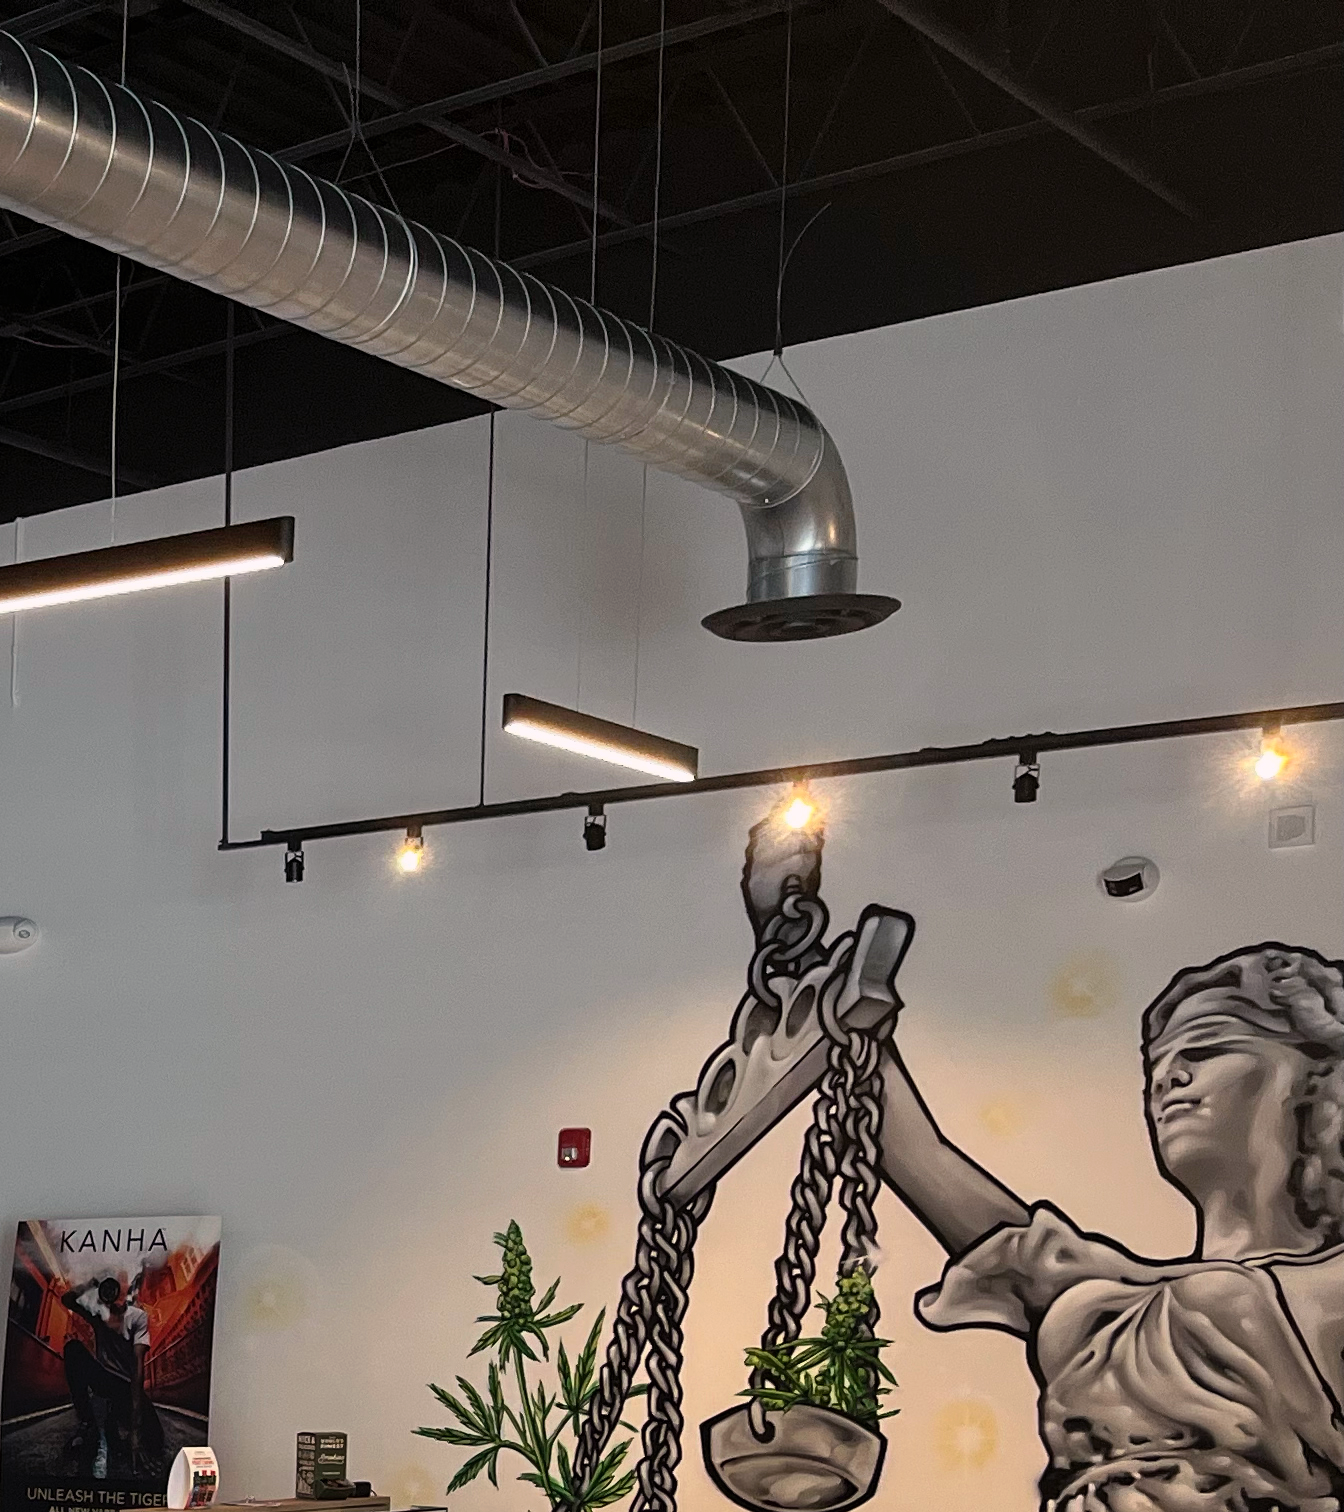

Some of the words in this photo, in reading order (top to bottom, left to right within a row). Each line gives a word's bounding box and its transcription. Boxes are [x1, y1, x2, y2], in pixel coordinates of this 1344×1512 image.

[59, 1227, 169, 1253] KANHA
[27, 1487, 94, 1503] UNLEASH
[97, 1490, 126, 1505] THE
